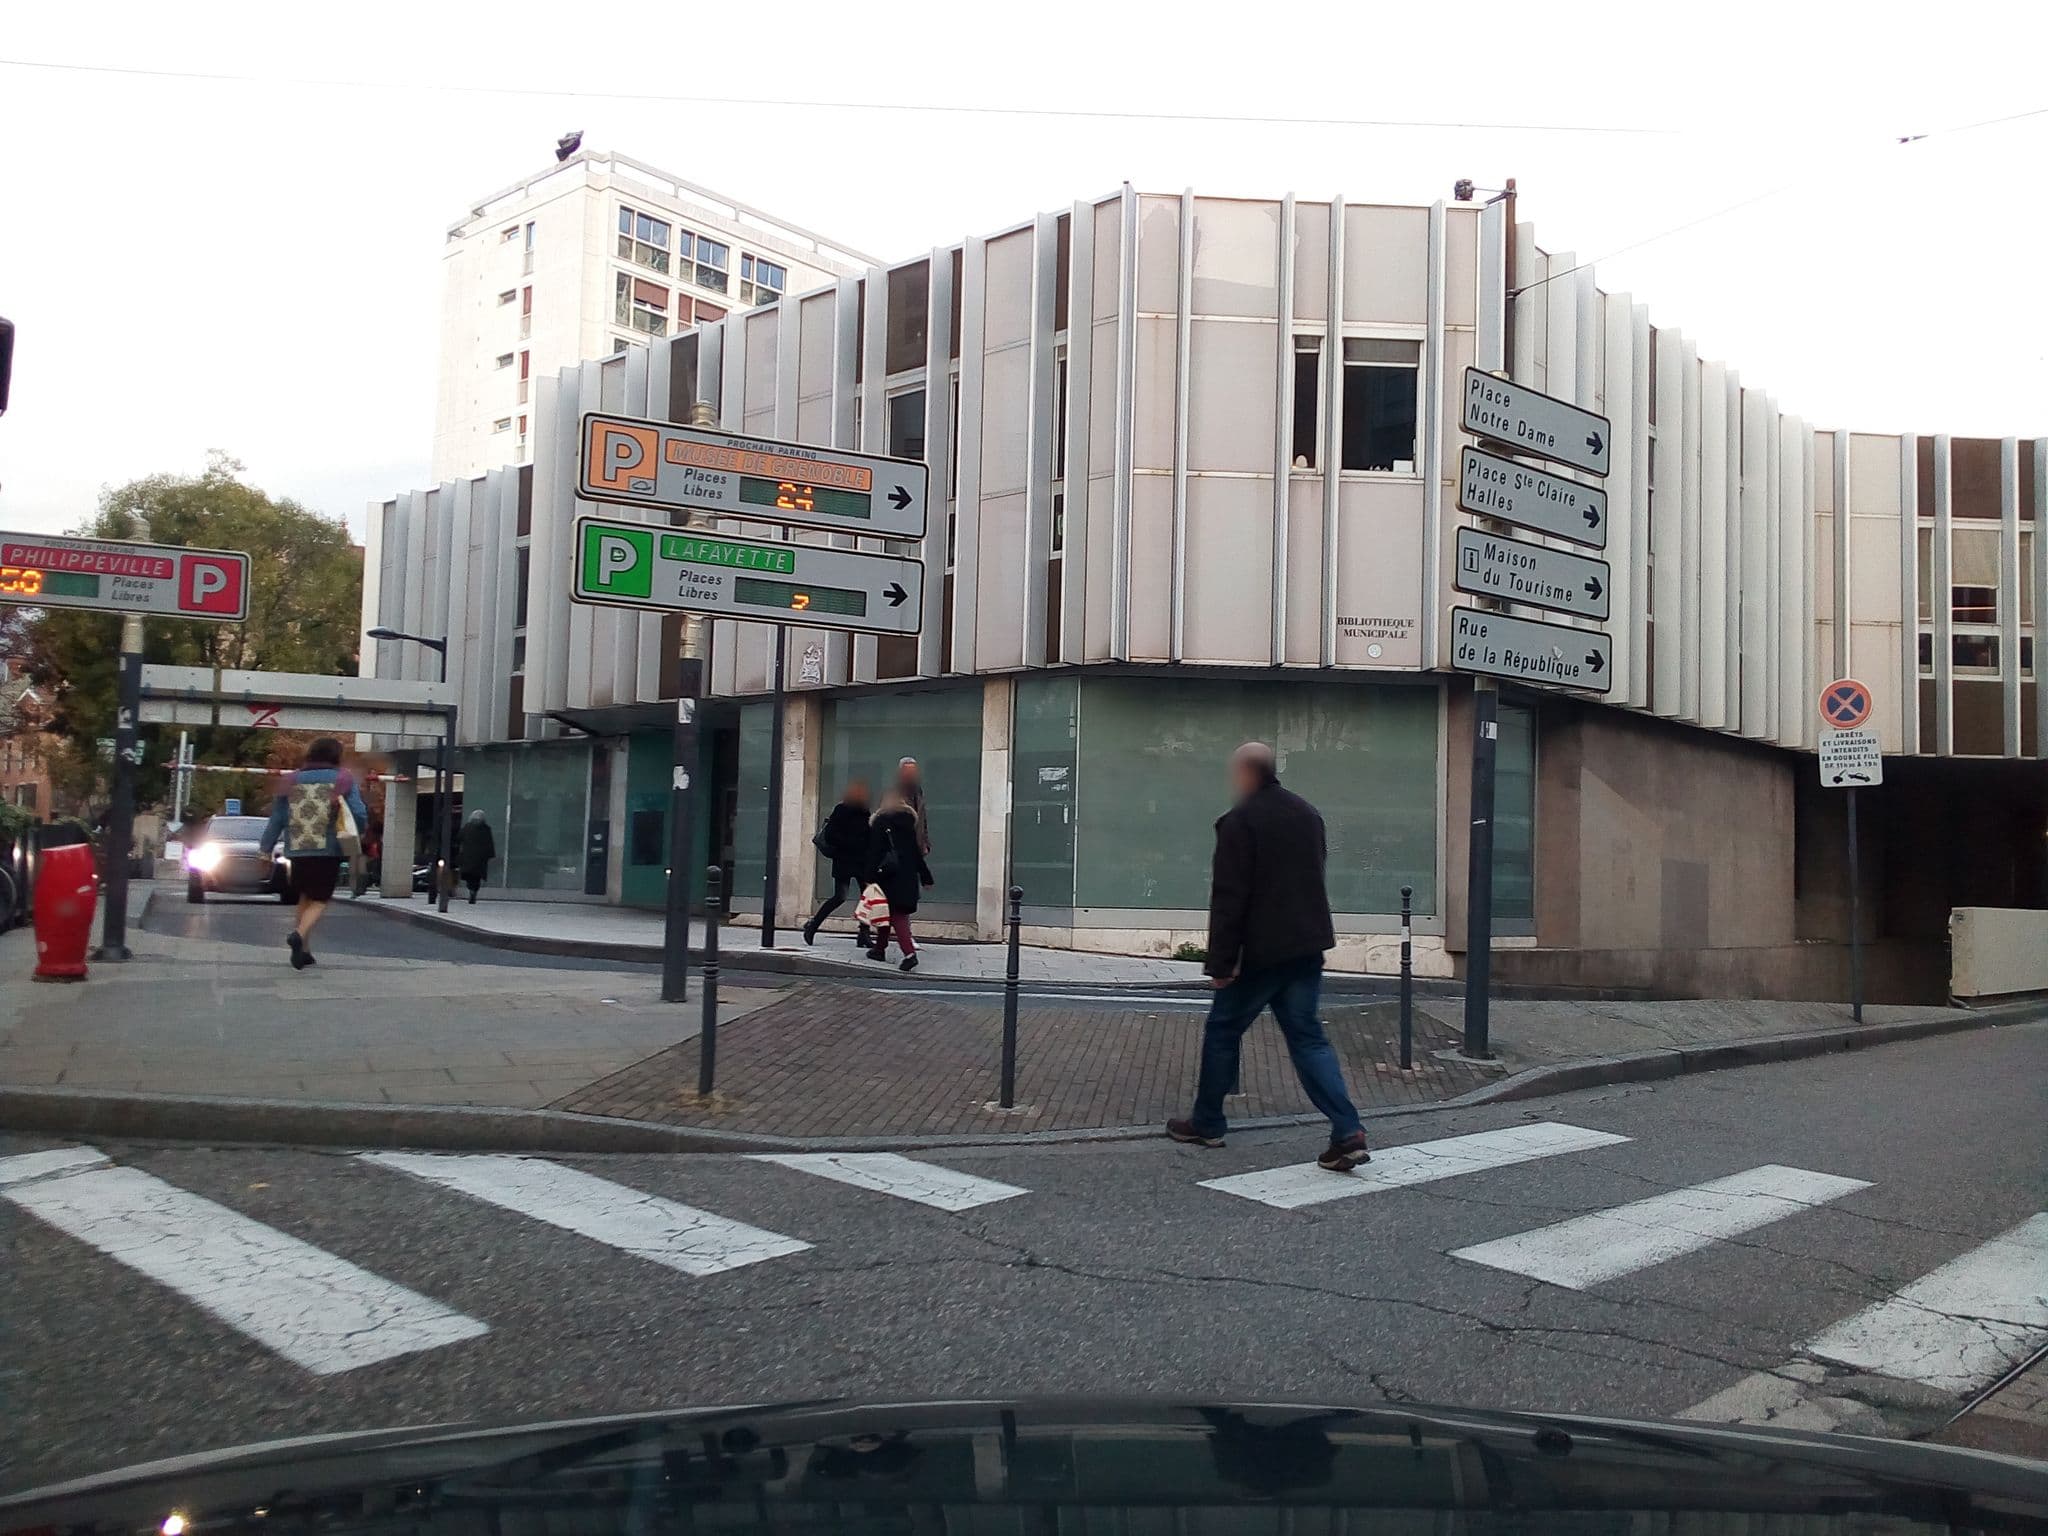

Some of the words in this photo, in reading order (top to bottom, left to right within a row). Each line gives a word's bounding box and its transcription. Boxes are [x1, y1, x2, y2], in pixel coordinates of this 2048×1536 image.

[1471, 379, 1511, 408] Place
[1470, 403, 1510, 431] Notre
[1518, 420, 1556, 447] Dame
[603, 430, 644, 482] P
[727, 439, 774, 454] PROCHAIN
[778, 447, 817, 460] PARKING
[684, 468, 728, 485] Places
[743, 453, 767, 471] DE
[771, 458, 865, 486] GRENOBLE
[1468, 458, 1507, 486] Place
[1538, 477, 1577, 507] Claire
[683, 484, 723, 500] Libres
[1467, 486, 1514, 512] Halles
[9, 547, 165, 576] PHILIPPEVILLE
[598, 535, 638, 585] P
[668, 539, 787, 571] LAFAYETTE
[1484, 542, 1537, 571] Maison
[112, 577, 154, 590] Places
[191, 563, 227, 604] P
[679, 570, 723, 586] Places
[1482, 568, 1501, 587] du
[1509, 573, 1573, 602] Tourisme
[111, 590, 150, 603] Libres
[678, 586, 718, 602] Libres
[1337, 617, 1414, 628] BIBLIOTHEQUE
[1344, 629, 1408, 639] MUNICIPALE
[1458, 617, 1488, 639] Rue
[1458, 642, 1476, 661] de
[1483, 645, 1497, 664] la
[1504, 649, 1581, 680] République
[1833, 738, 1877, 746] LIVRAISONS
[1833, 753, 1861, 761] DOUBLE
